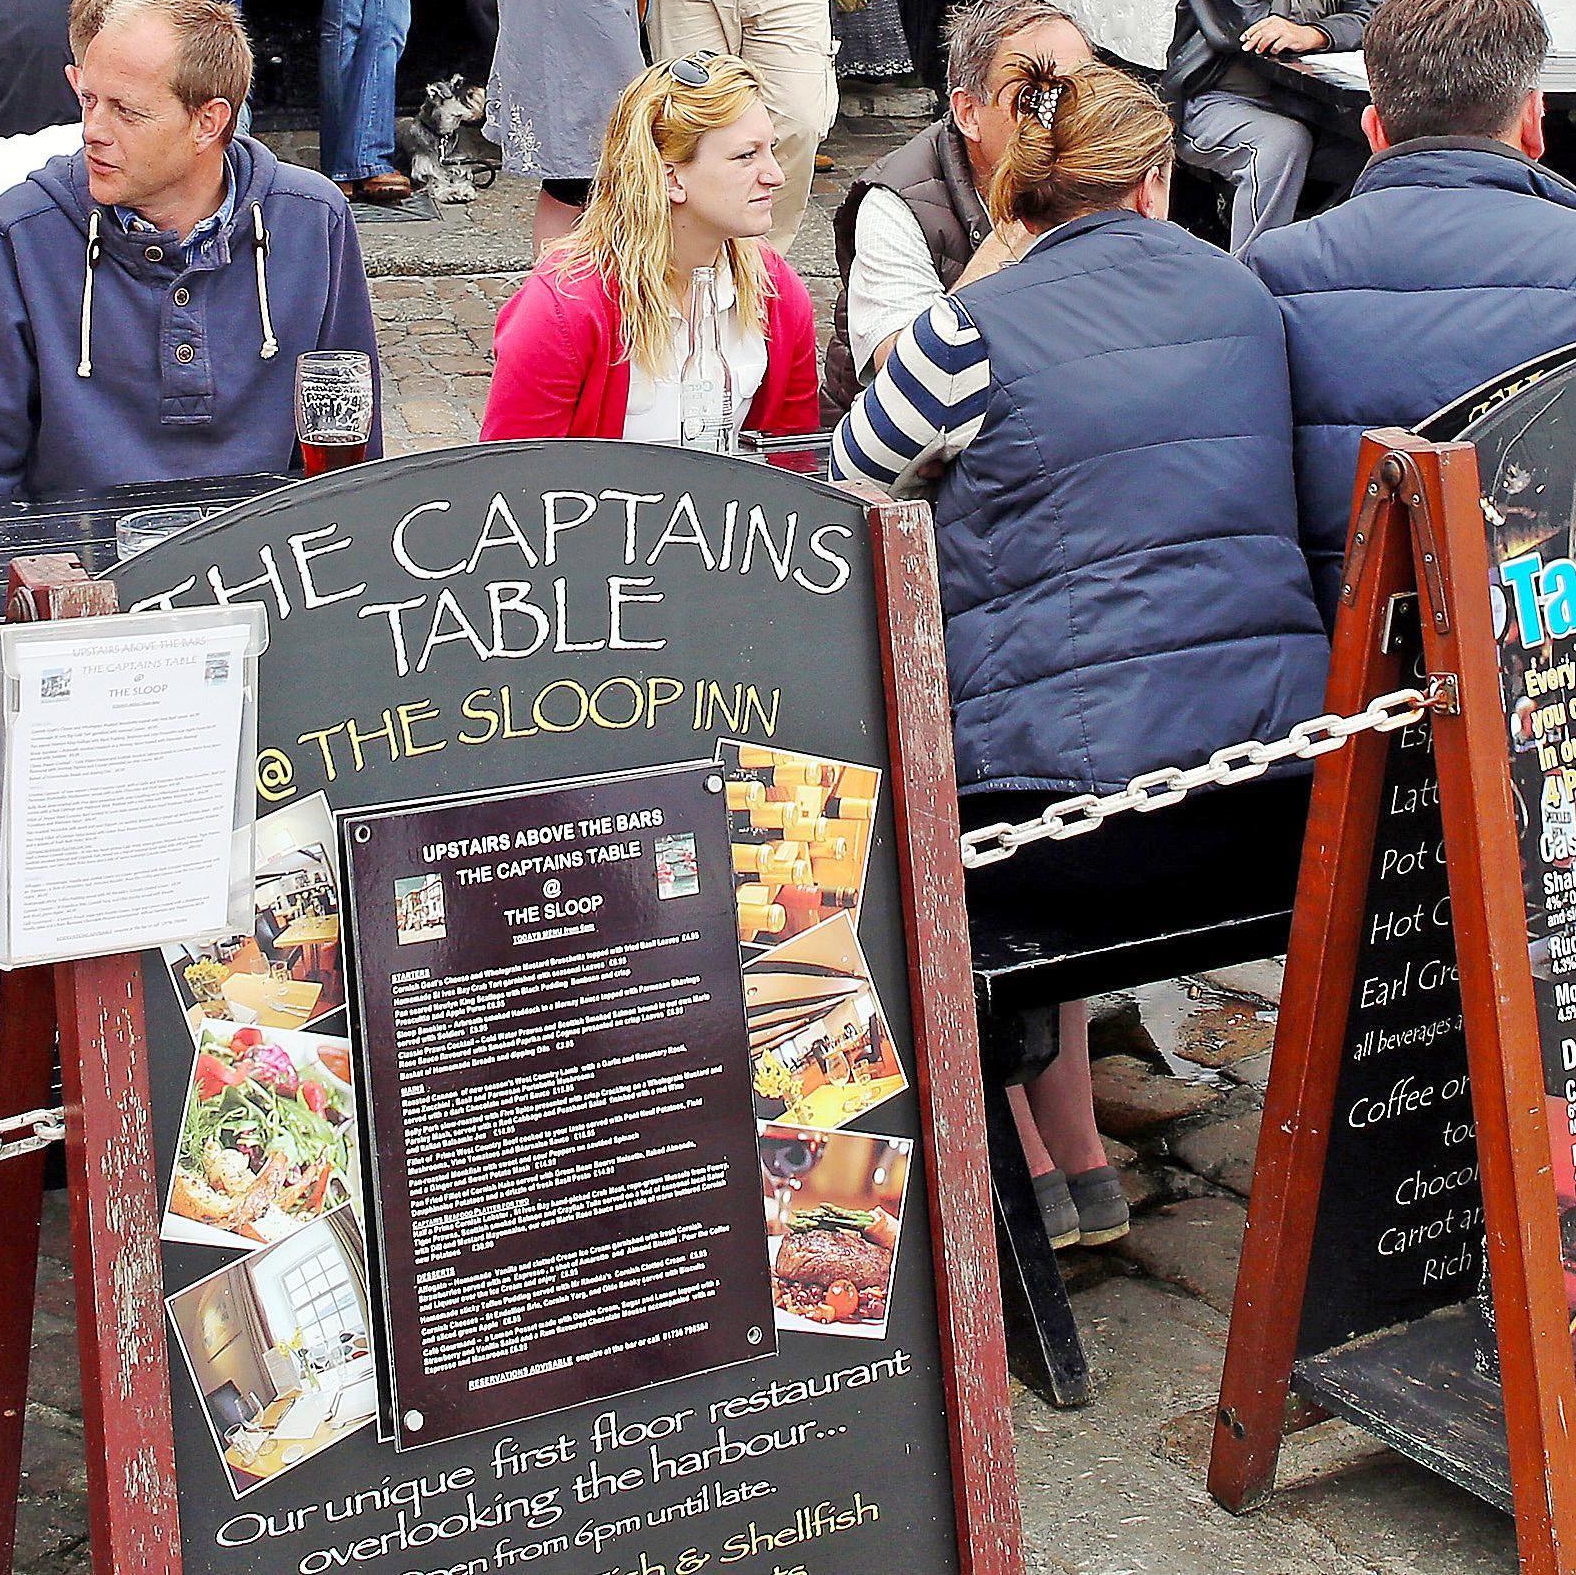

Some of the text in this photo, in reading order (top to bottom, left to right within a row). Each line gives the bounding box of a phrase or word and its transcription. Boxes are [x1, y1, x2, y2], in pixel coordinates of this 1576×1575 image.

[128, 489, 853, 619] THE CAPTAINS
[359, 576, 666, 677] TABLE
[256, 677, 780, 801] @ THE SLOOP INN
[1546, 775, 1560, 807] 4
[423, 808, 664, 862] UPSTAIRS ABOVE THE BARS
[456, 841, 642, 885] THE CAPTAINS TABLE
[504, 895, 604, 925] THE SLOOP
[543, 879, 561, 898] @
[216, 1350, 911, 1547] Our unique first floor restaurant
[299, 1421, 847, 1575] overlooking the harbour...
